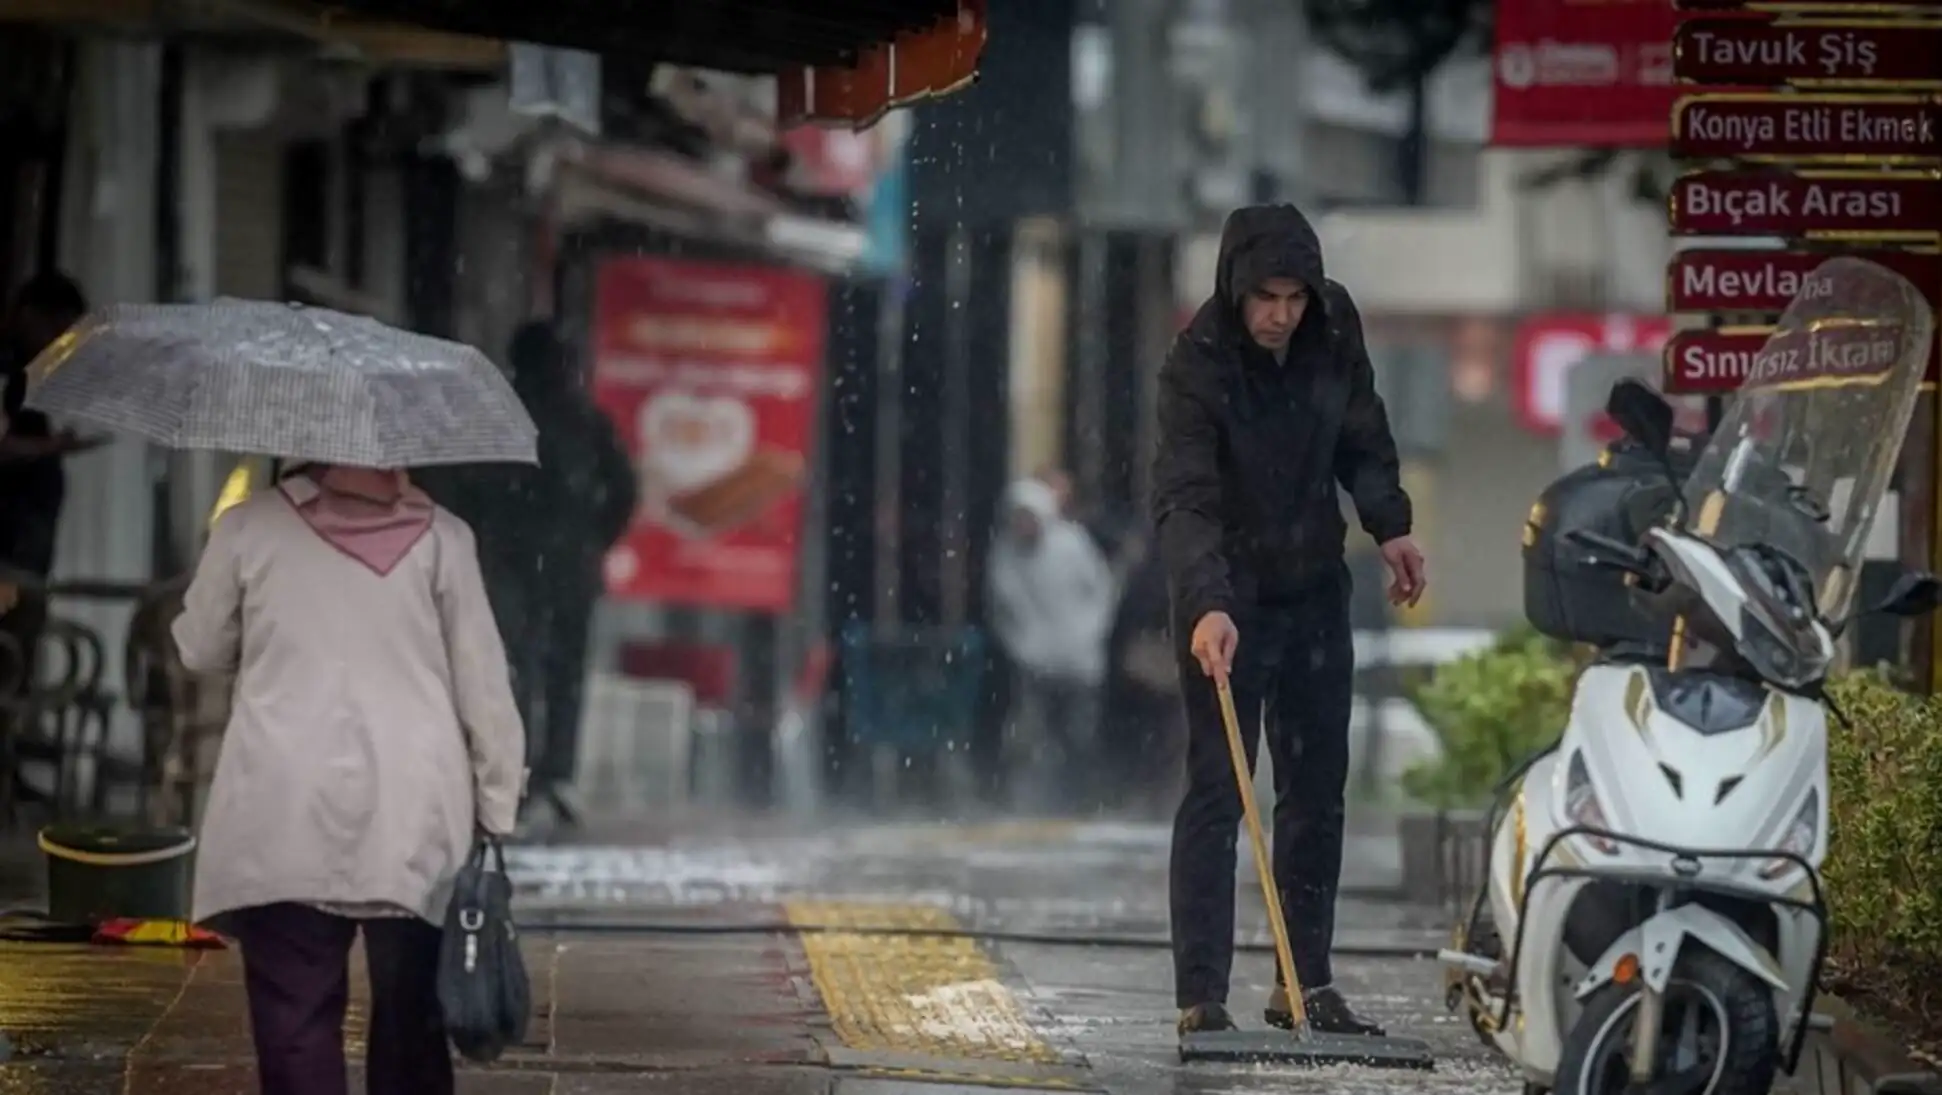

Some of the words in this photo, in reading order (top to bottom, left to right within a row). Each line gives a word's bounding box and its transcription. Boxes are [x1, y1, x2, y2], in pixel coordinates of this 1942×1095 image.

[1691, 32, 1807, 65] Tavuk
[1819, 33, 1877, 74] Şiş
[1689, 108, 1774, 149] Konya
[1784, 109, 1831, 141] Etli
[1840, 109, 1935, 142] Ekmek
[1687, 183, 1790, 224] Bıçak
[1801, 185, 1901, 217] Arası
[1683, 263, 1834, 299] Mevlana
[1684, 345, 1799, 380] Sınırsız
